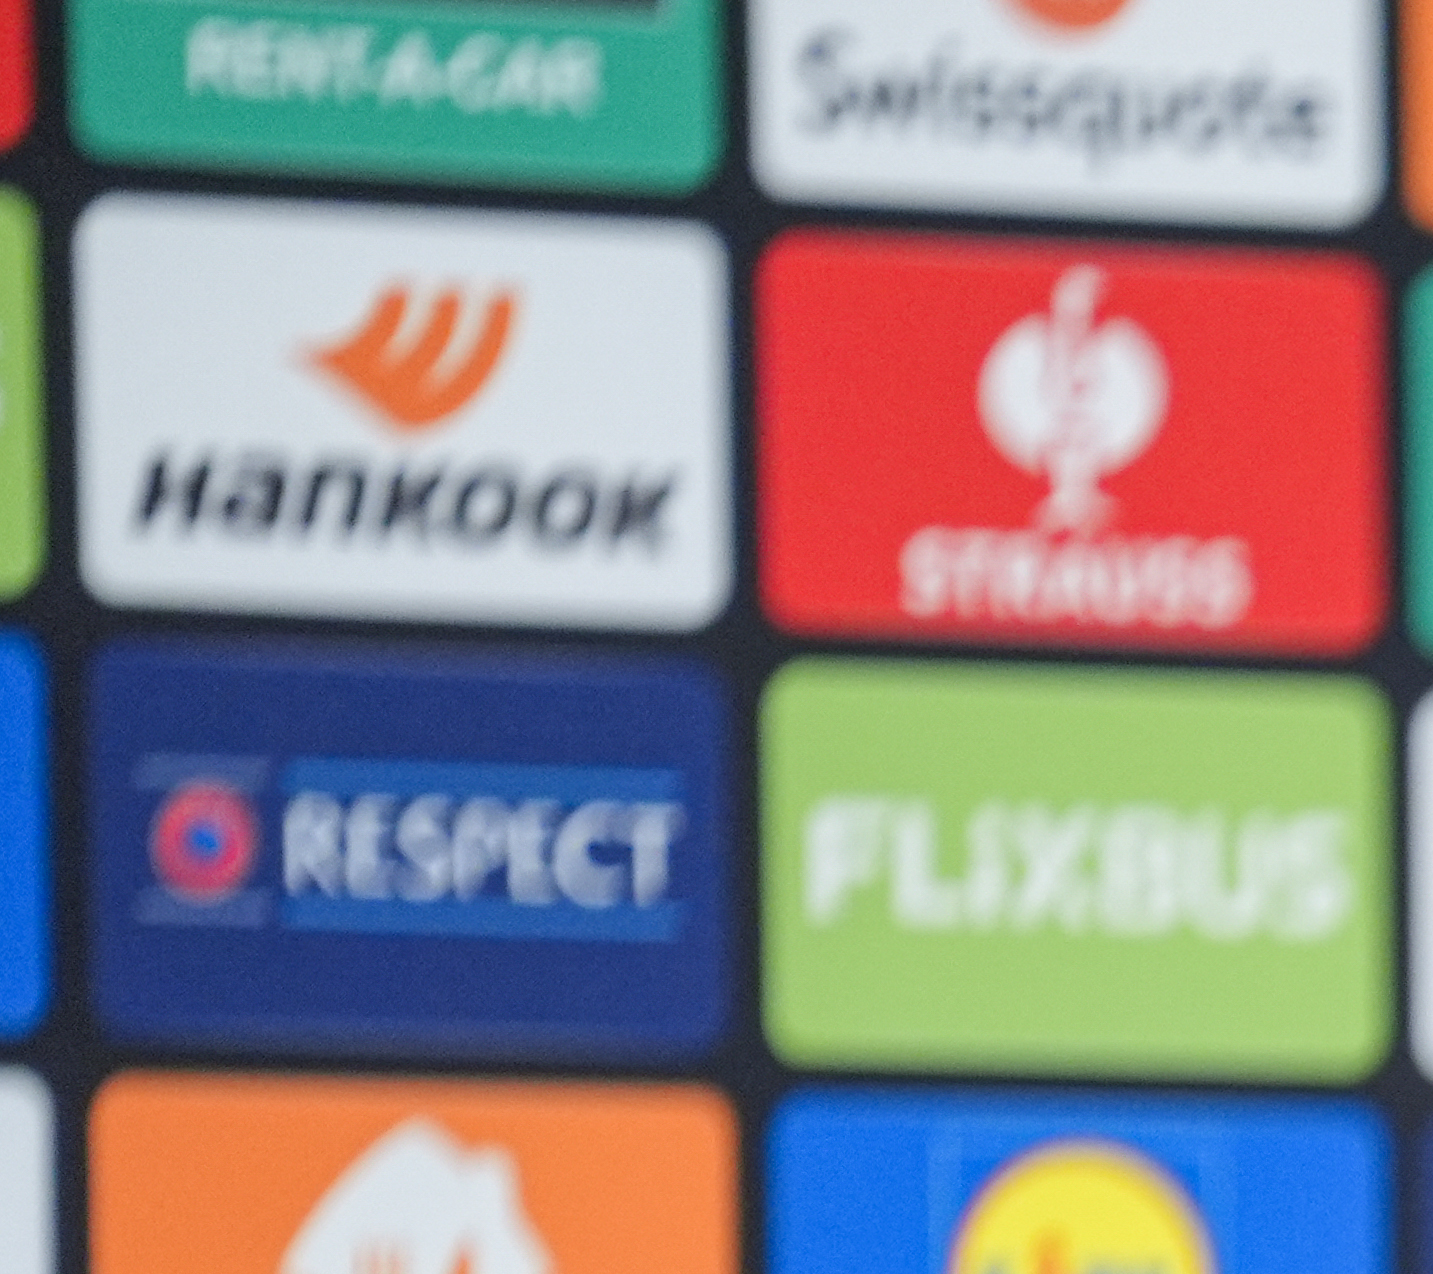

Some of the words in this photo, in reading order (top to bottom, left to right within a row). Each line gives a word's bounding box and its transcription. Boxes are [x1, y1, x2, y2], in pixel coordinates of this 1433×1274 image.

[797, 27, 1337, 171] Swissquote
[898, 525, 1253, 629] STRAUSS
[281, 791, 684, 908] RESPECT
